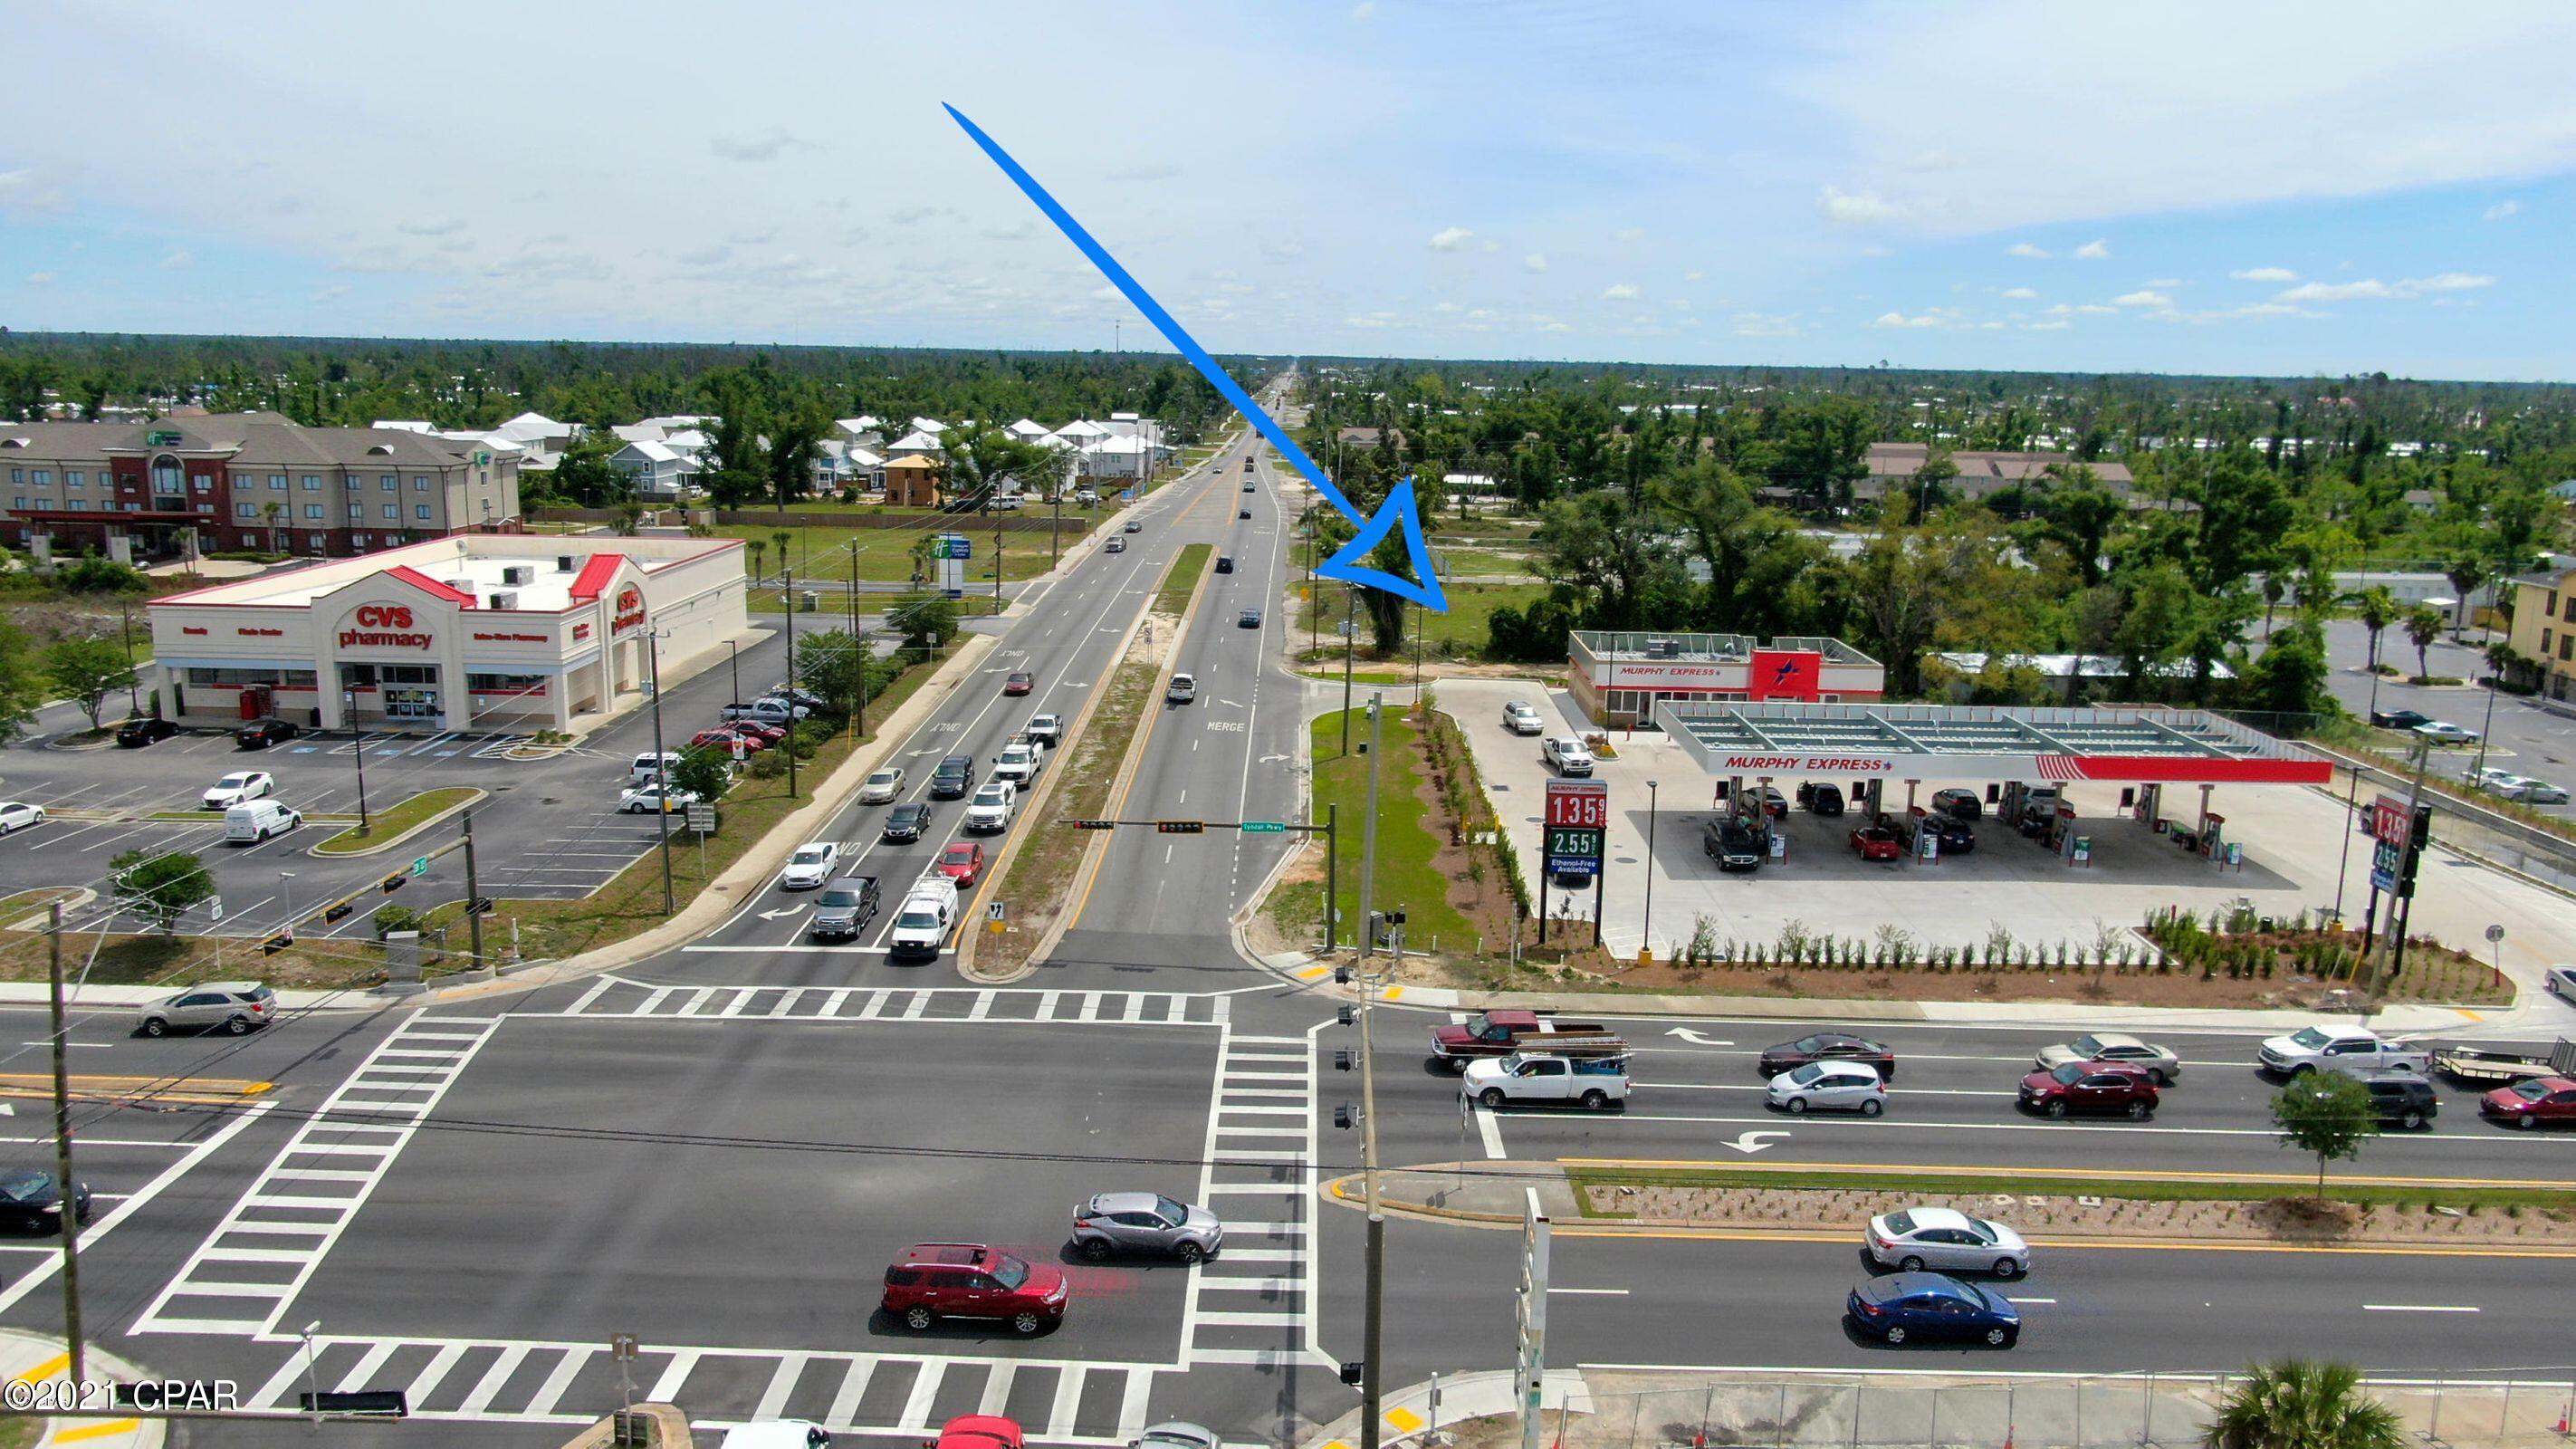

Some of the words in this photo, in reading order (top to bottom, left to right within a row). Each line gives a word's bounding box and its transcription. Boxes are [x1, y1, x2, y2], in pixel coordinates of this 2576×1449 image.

[356, 606, 413, 629] CVS
[339, 629, 433, 650] pharmacy
[1207, 722, 1245, 732] MERGE
[1724, 757, 1801, 769] MURPHY
[1805, 758, 1882, 770] EXPRESS
[1551, 859, 1596, 867] Ethanol-Free
